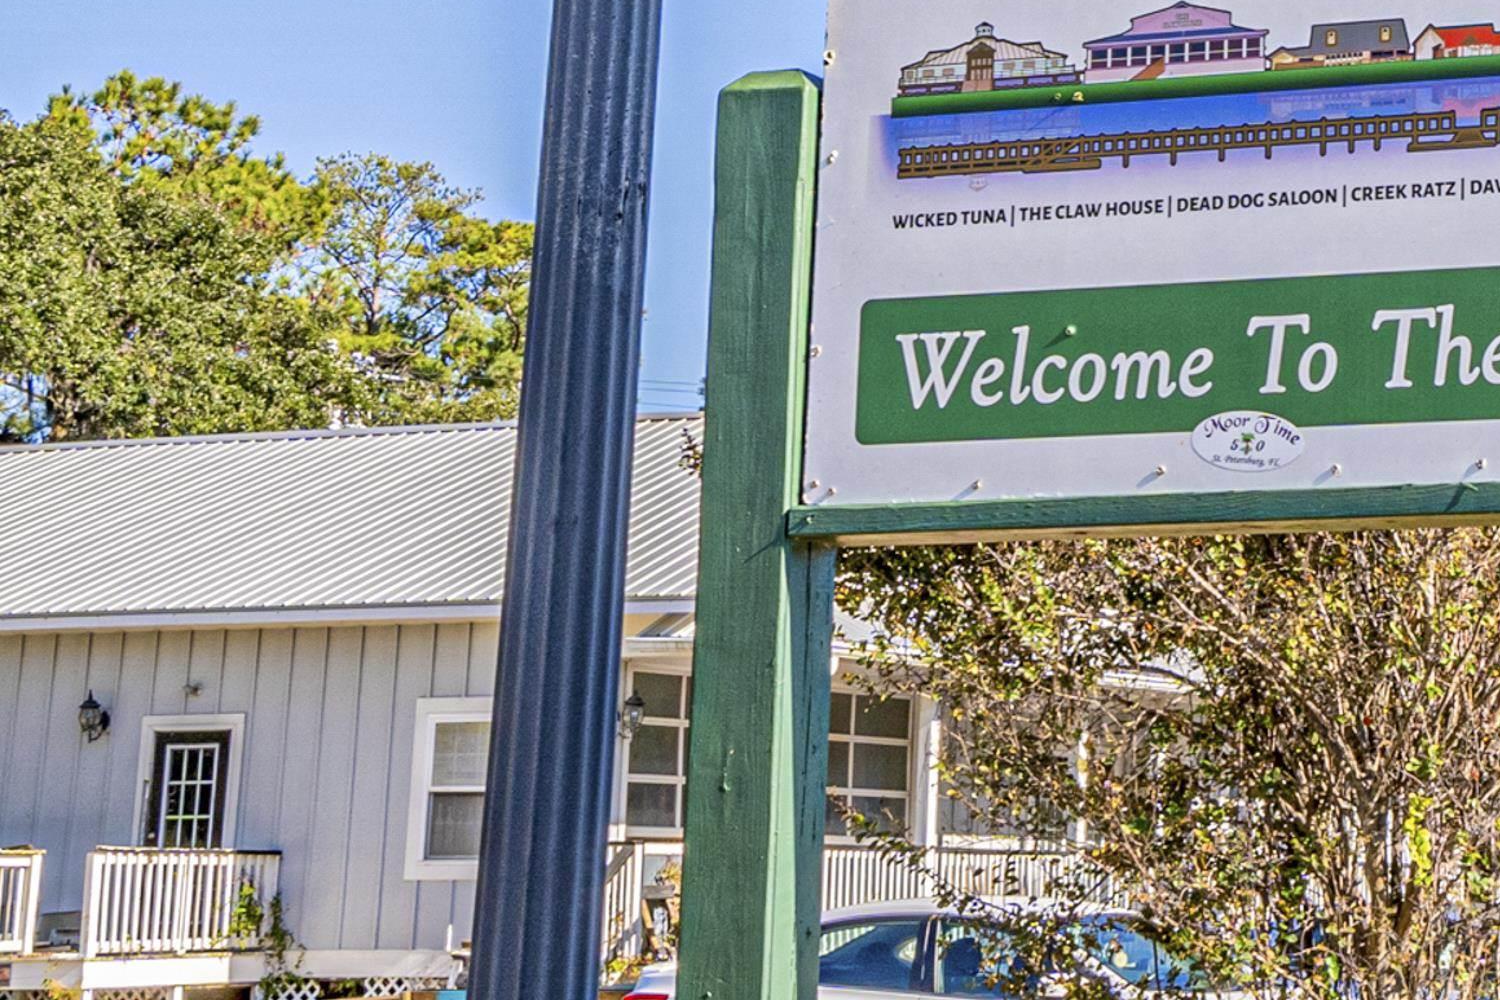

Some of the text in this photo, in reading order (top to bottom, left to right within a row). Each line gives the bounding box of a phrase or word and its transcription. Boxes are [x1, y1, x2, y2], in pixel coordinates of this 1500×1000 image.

[1177, 188, 1338, 213] DEAD DOG SALOON
[1351, 181, 1456, 201] CREEK RATZ
[892, 208, 1007, 230] WICKED TUNA
[1019, 199, 1165, 222] THE CLAW HOUSE
[895, 325, 1214, 410] Welcome
[1246, 313, 1338, 395] To
[1204, 414, 1301, 445] Moor Time
